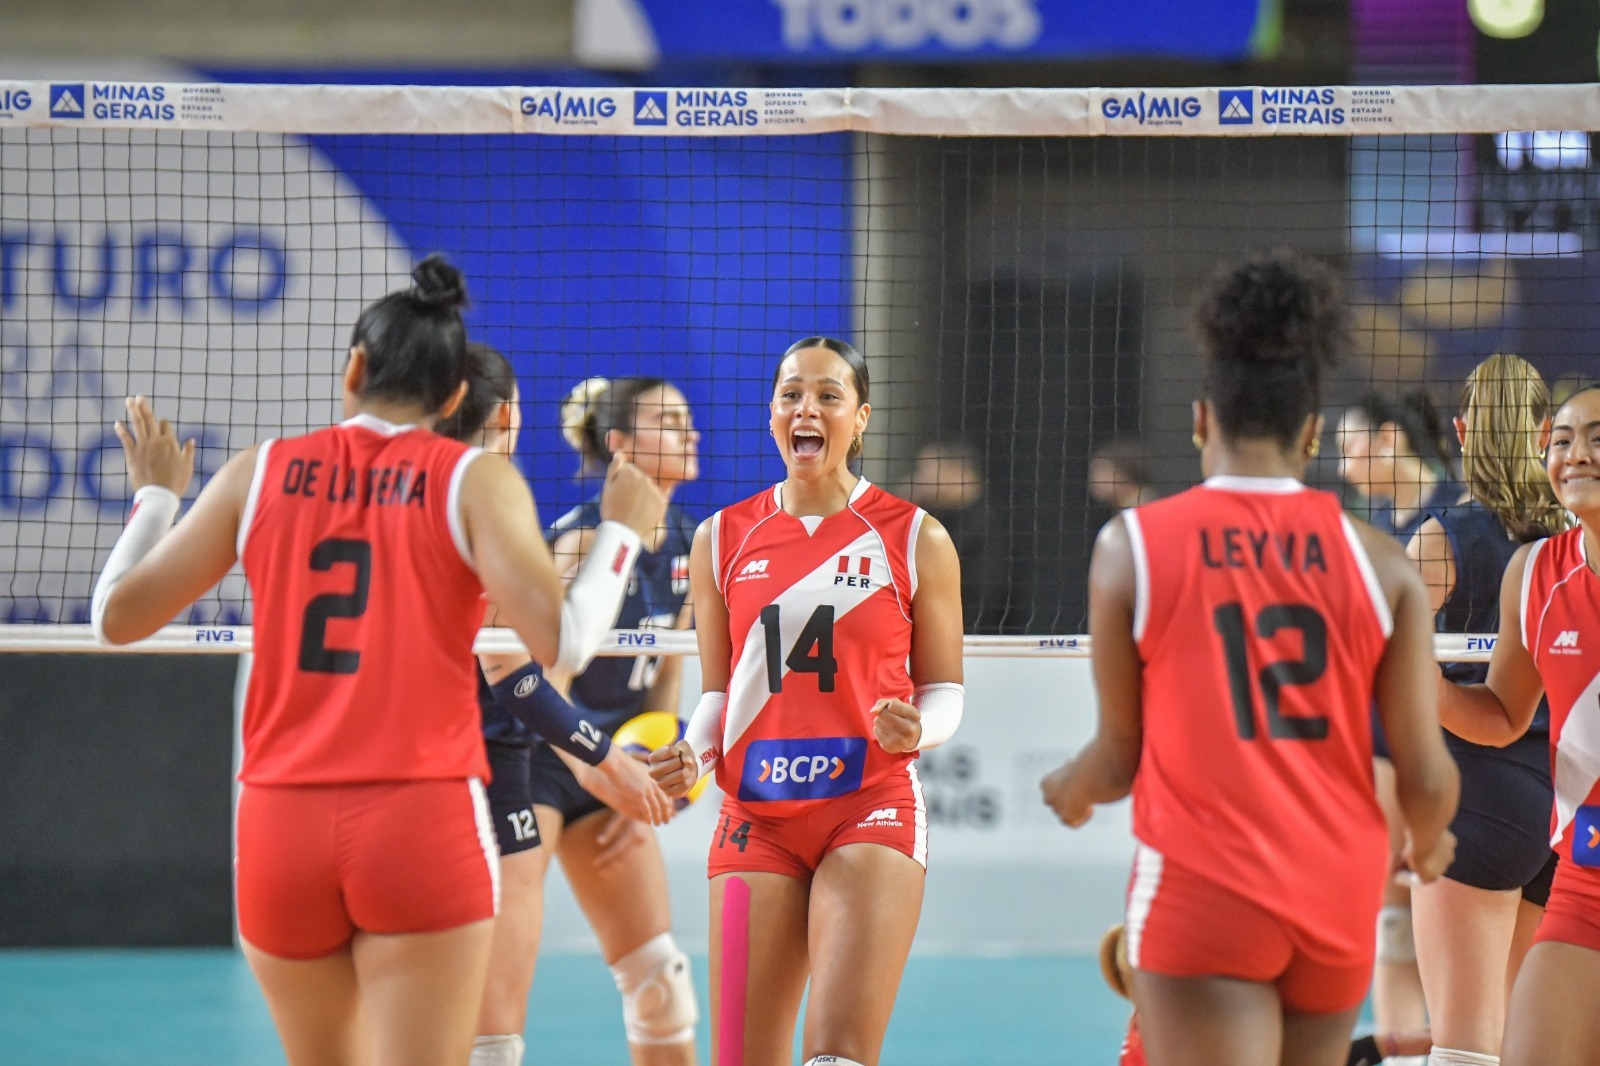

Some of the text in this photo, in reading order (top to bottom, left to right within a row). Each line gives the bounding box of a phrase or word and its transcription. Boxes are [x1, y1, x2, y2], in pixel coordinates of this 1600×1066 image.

[0, 90, 32, 110] IG
[92, 84, 165, 101] MINAS
[520, 90, 617, 124] GASMIG
[675, 90, 748, 107] MINAS
[1261, 89, 1335, 105] MINAS
[93, 103, 175, 120] GERAIS
[675, 110, 758, 126] GERAIS
[1101, 91, 1202, 125] GASMIG
[1261, 107, 1345, 125] GERAIS
[283, 458, 322, 497] DE
[1201, 527, 1327, 573] LEYVA
[833, 576, 871, 589] PER
[297, 537, 372, 675] 2
[760, 603, 838, 693] 14
[1467, 637, 1498, 650] FIV
[1213, 601, 1330, 741] 12
[569, 719, 601, 752] 12
[771, 756, 829, 784] BCP
[507, 809, 538, 842] 12
[718, 815, 752, 853] 14
